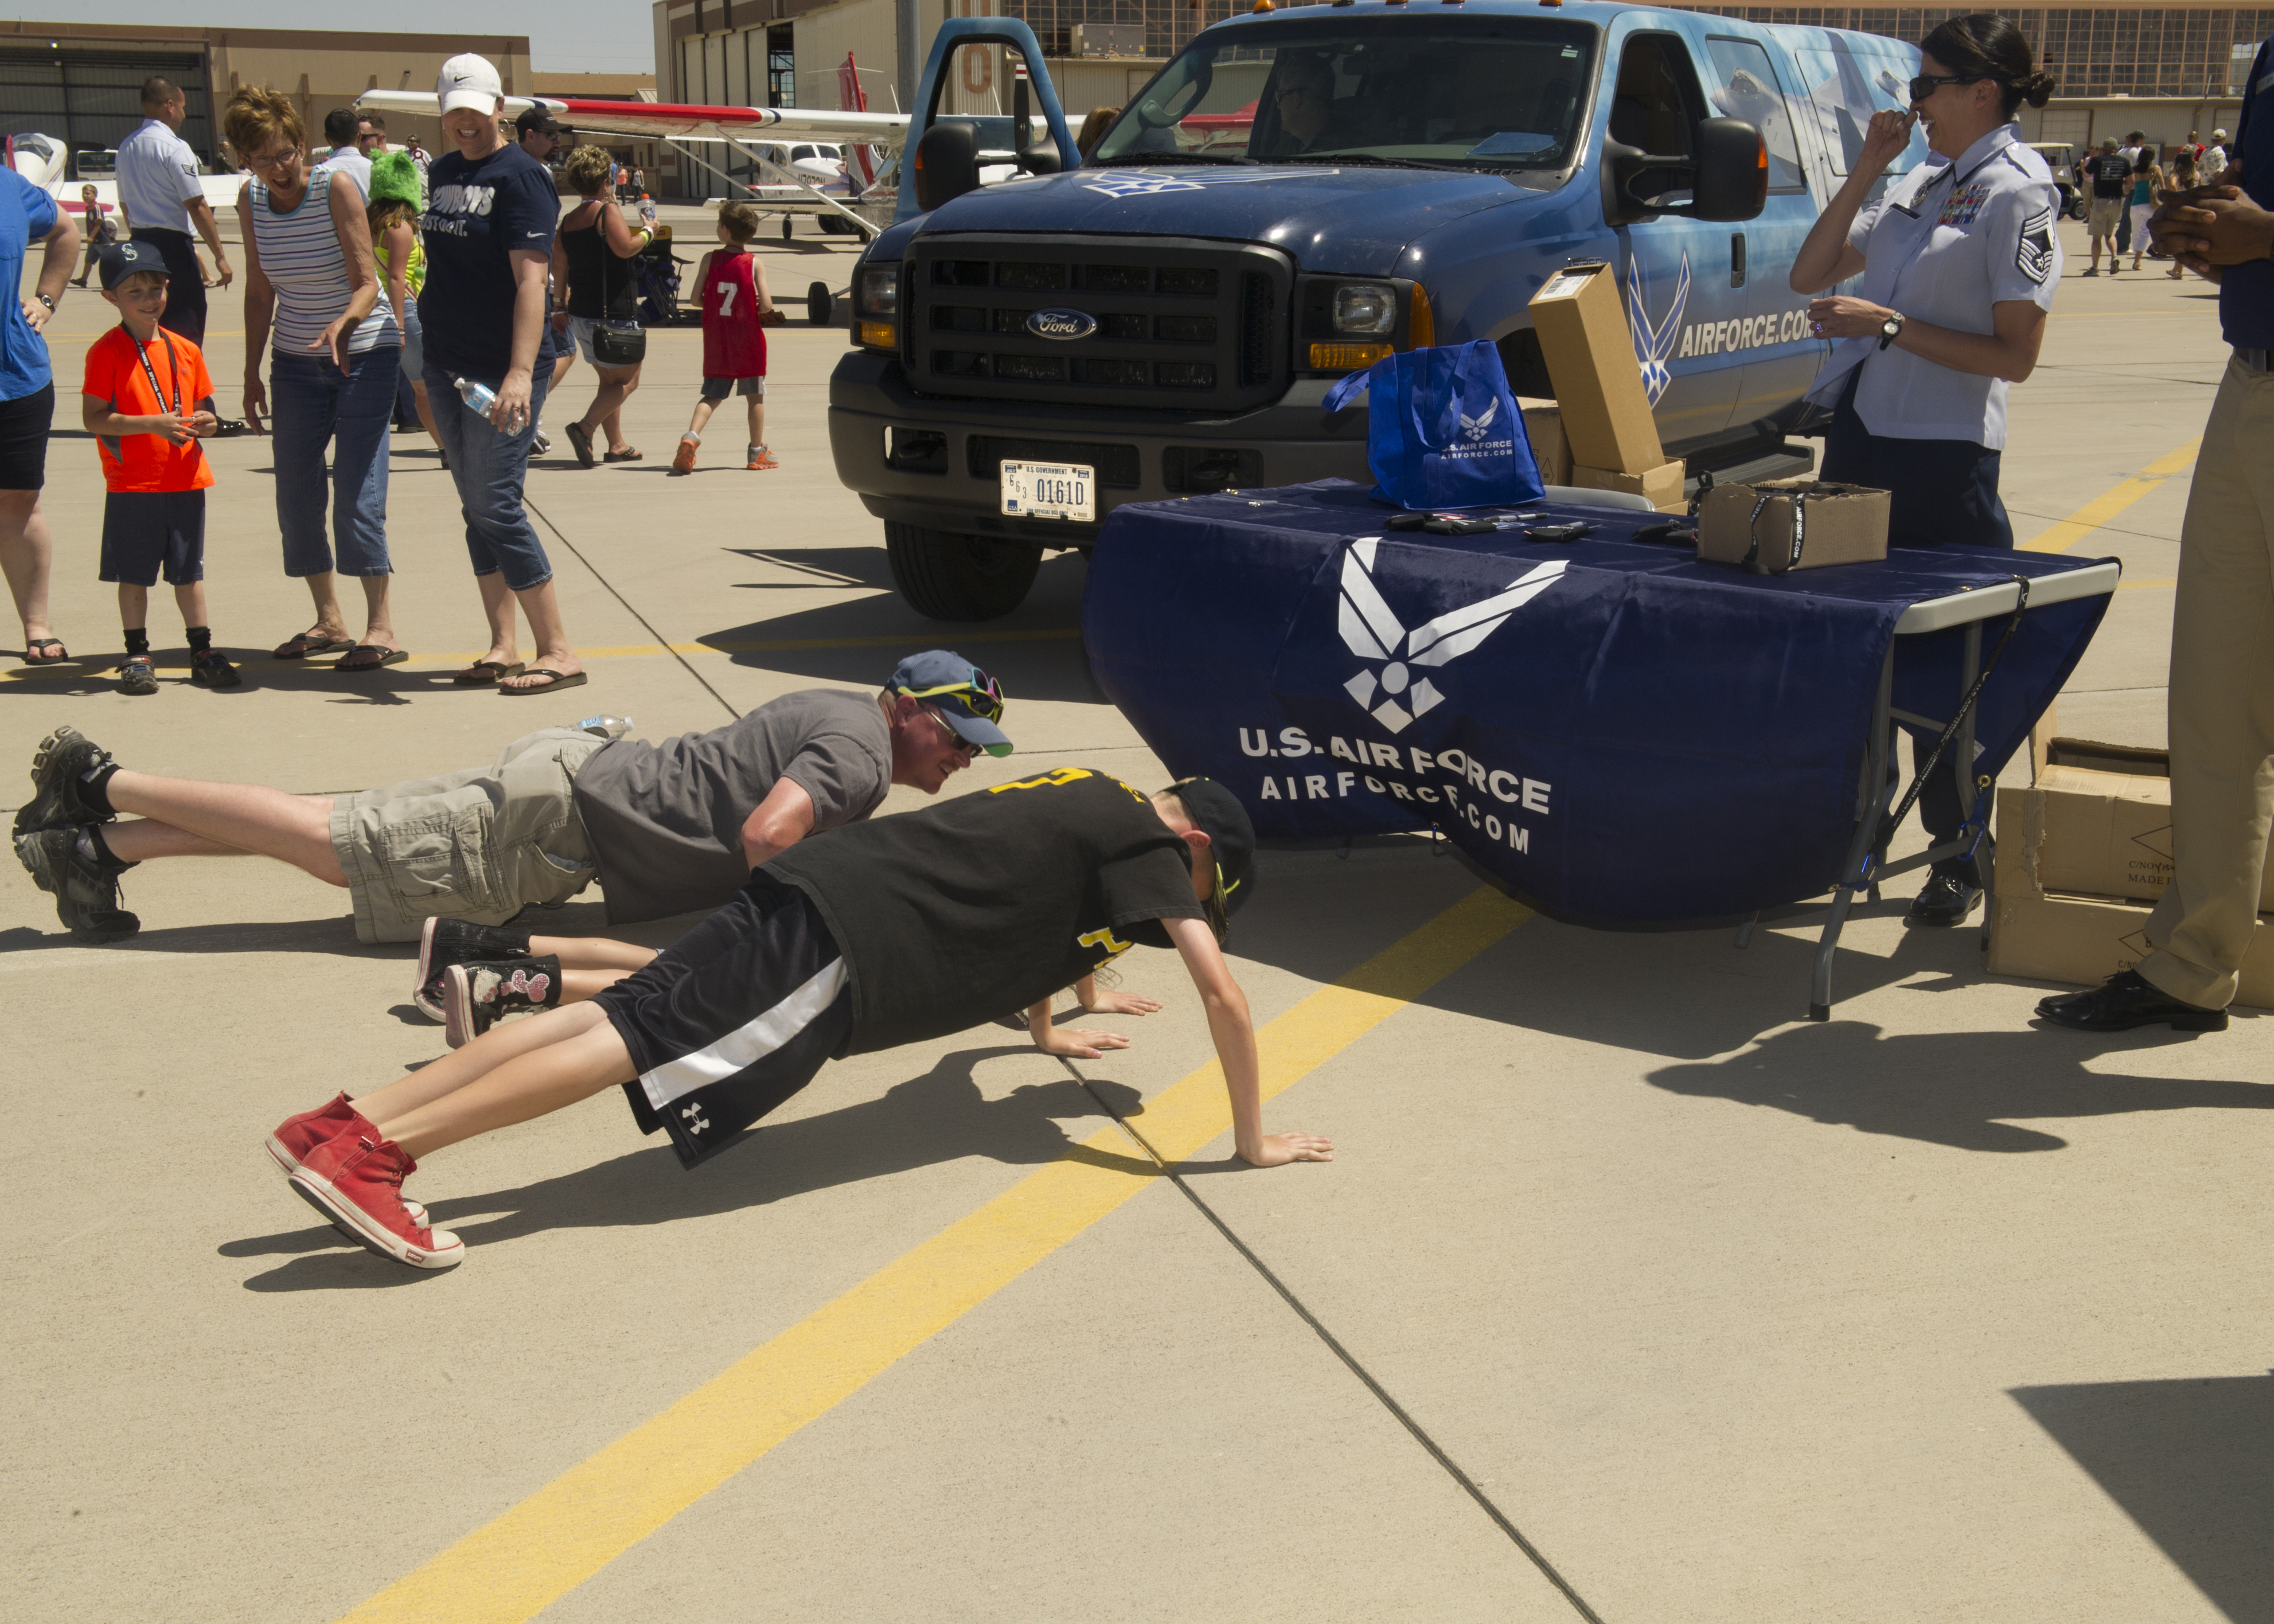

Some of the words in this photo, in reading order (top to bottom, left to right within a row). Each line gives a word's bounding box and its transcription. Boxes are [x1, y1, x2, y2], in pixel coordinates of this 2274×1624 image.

[717, 282, 738, 316] 7
[1040, 313, 1078, 333] Ford
[149, 372, 159, 392] SPECIAL
[157, 392, 168, 413] OPERATI
[1441, 449, 1512, 460] AIRFORCE.COM
[1460, 443, 1477, 451] AIR
[1479, 440, 1512, 448] FORCE
[1036, 467, 1067, 475] GOVERNMENT
[1037, 479, 1083, 505] 0161D
[1793, 506, 1803, 558] AIRFORCE.COM
[1239, 727, 1324, 758] U.S.
[1331, 736, 1404, 770] AIR
[1410, 747, 1551, 815] FORCE
[1261, 771, 1529, 855] AIRFORCE.COM
[2128, 873, 2164, 885] MADE
